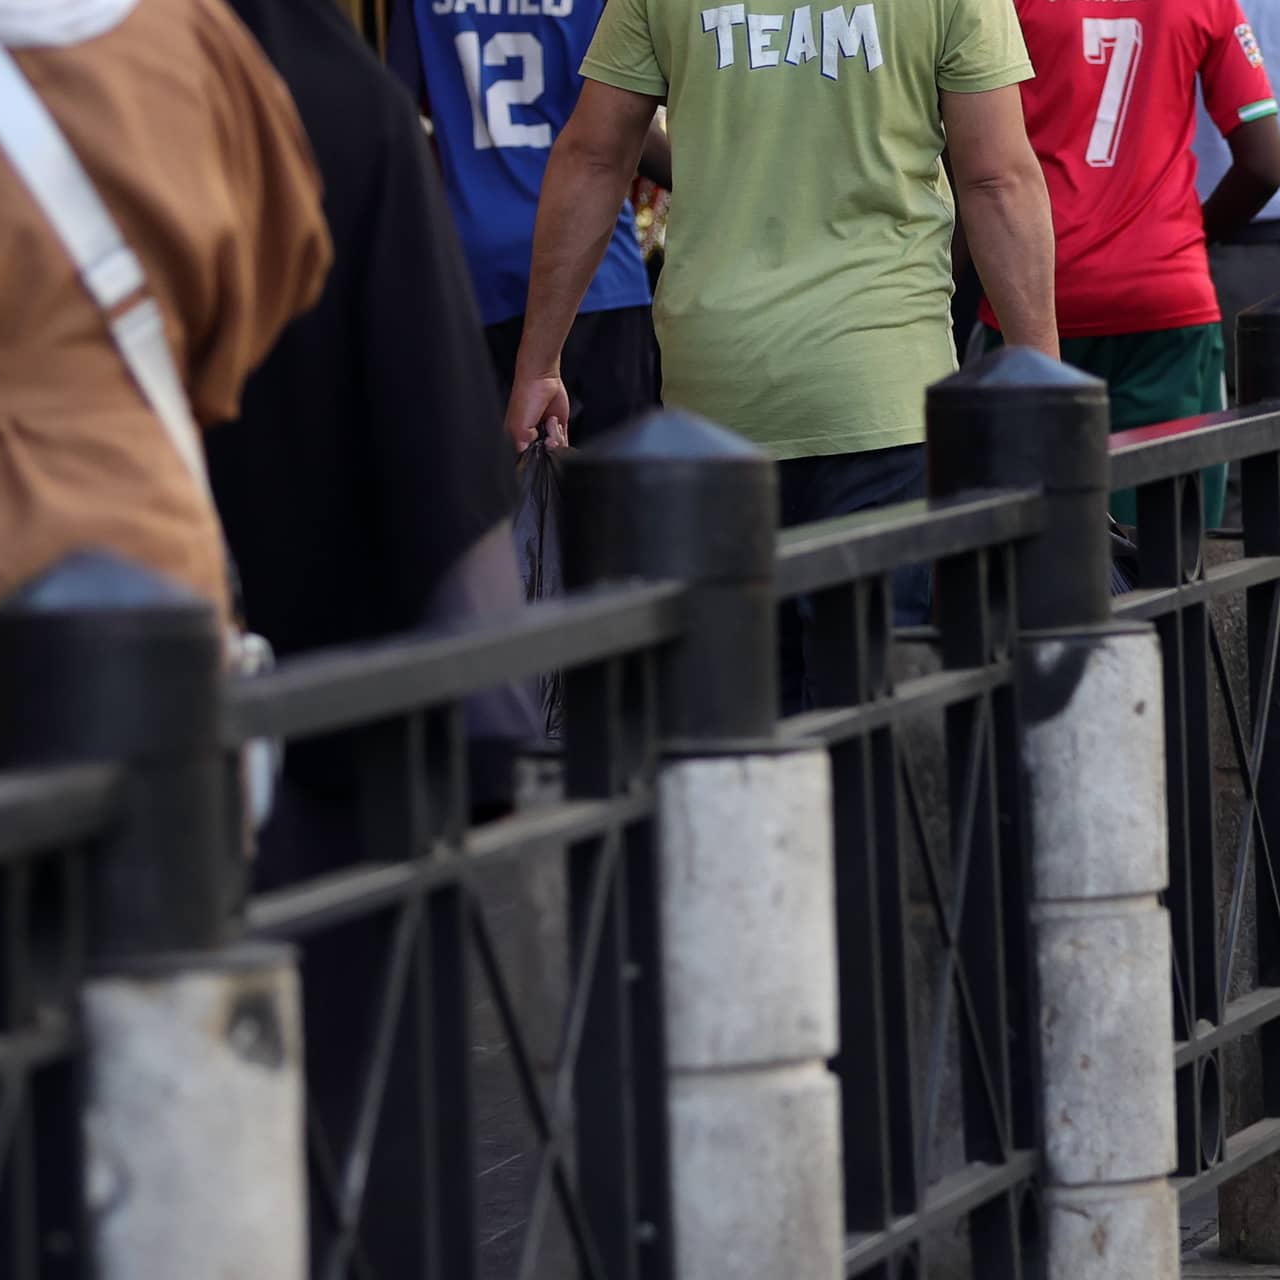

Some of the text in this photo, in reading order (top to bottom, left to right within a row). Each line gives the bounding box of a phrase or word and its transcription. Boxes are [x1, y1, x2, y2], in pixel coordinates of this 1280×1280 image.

[455, 31, 552, 150] 12
[701, 3, 884, 81] TEAM
[1082, 17, 1143, 168] 7
